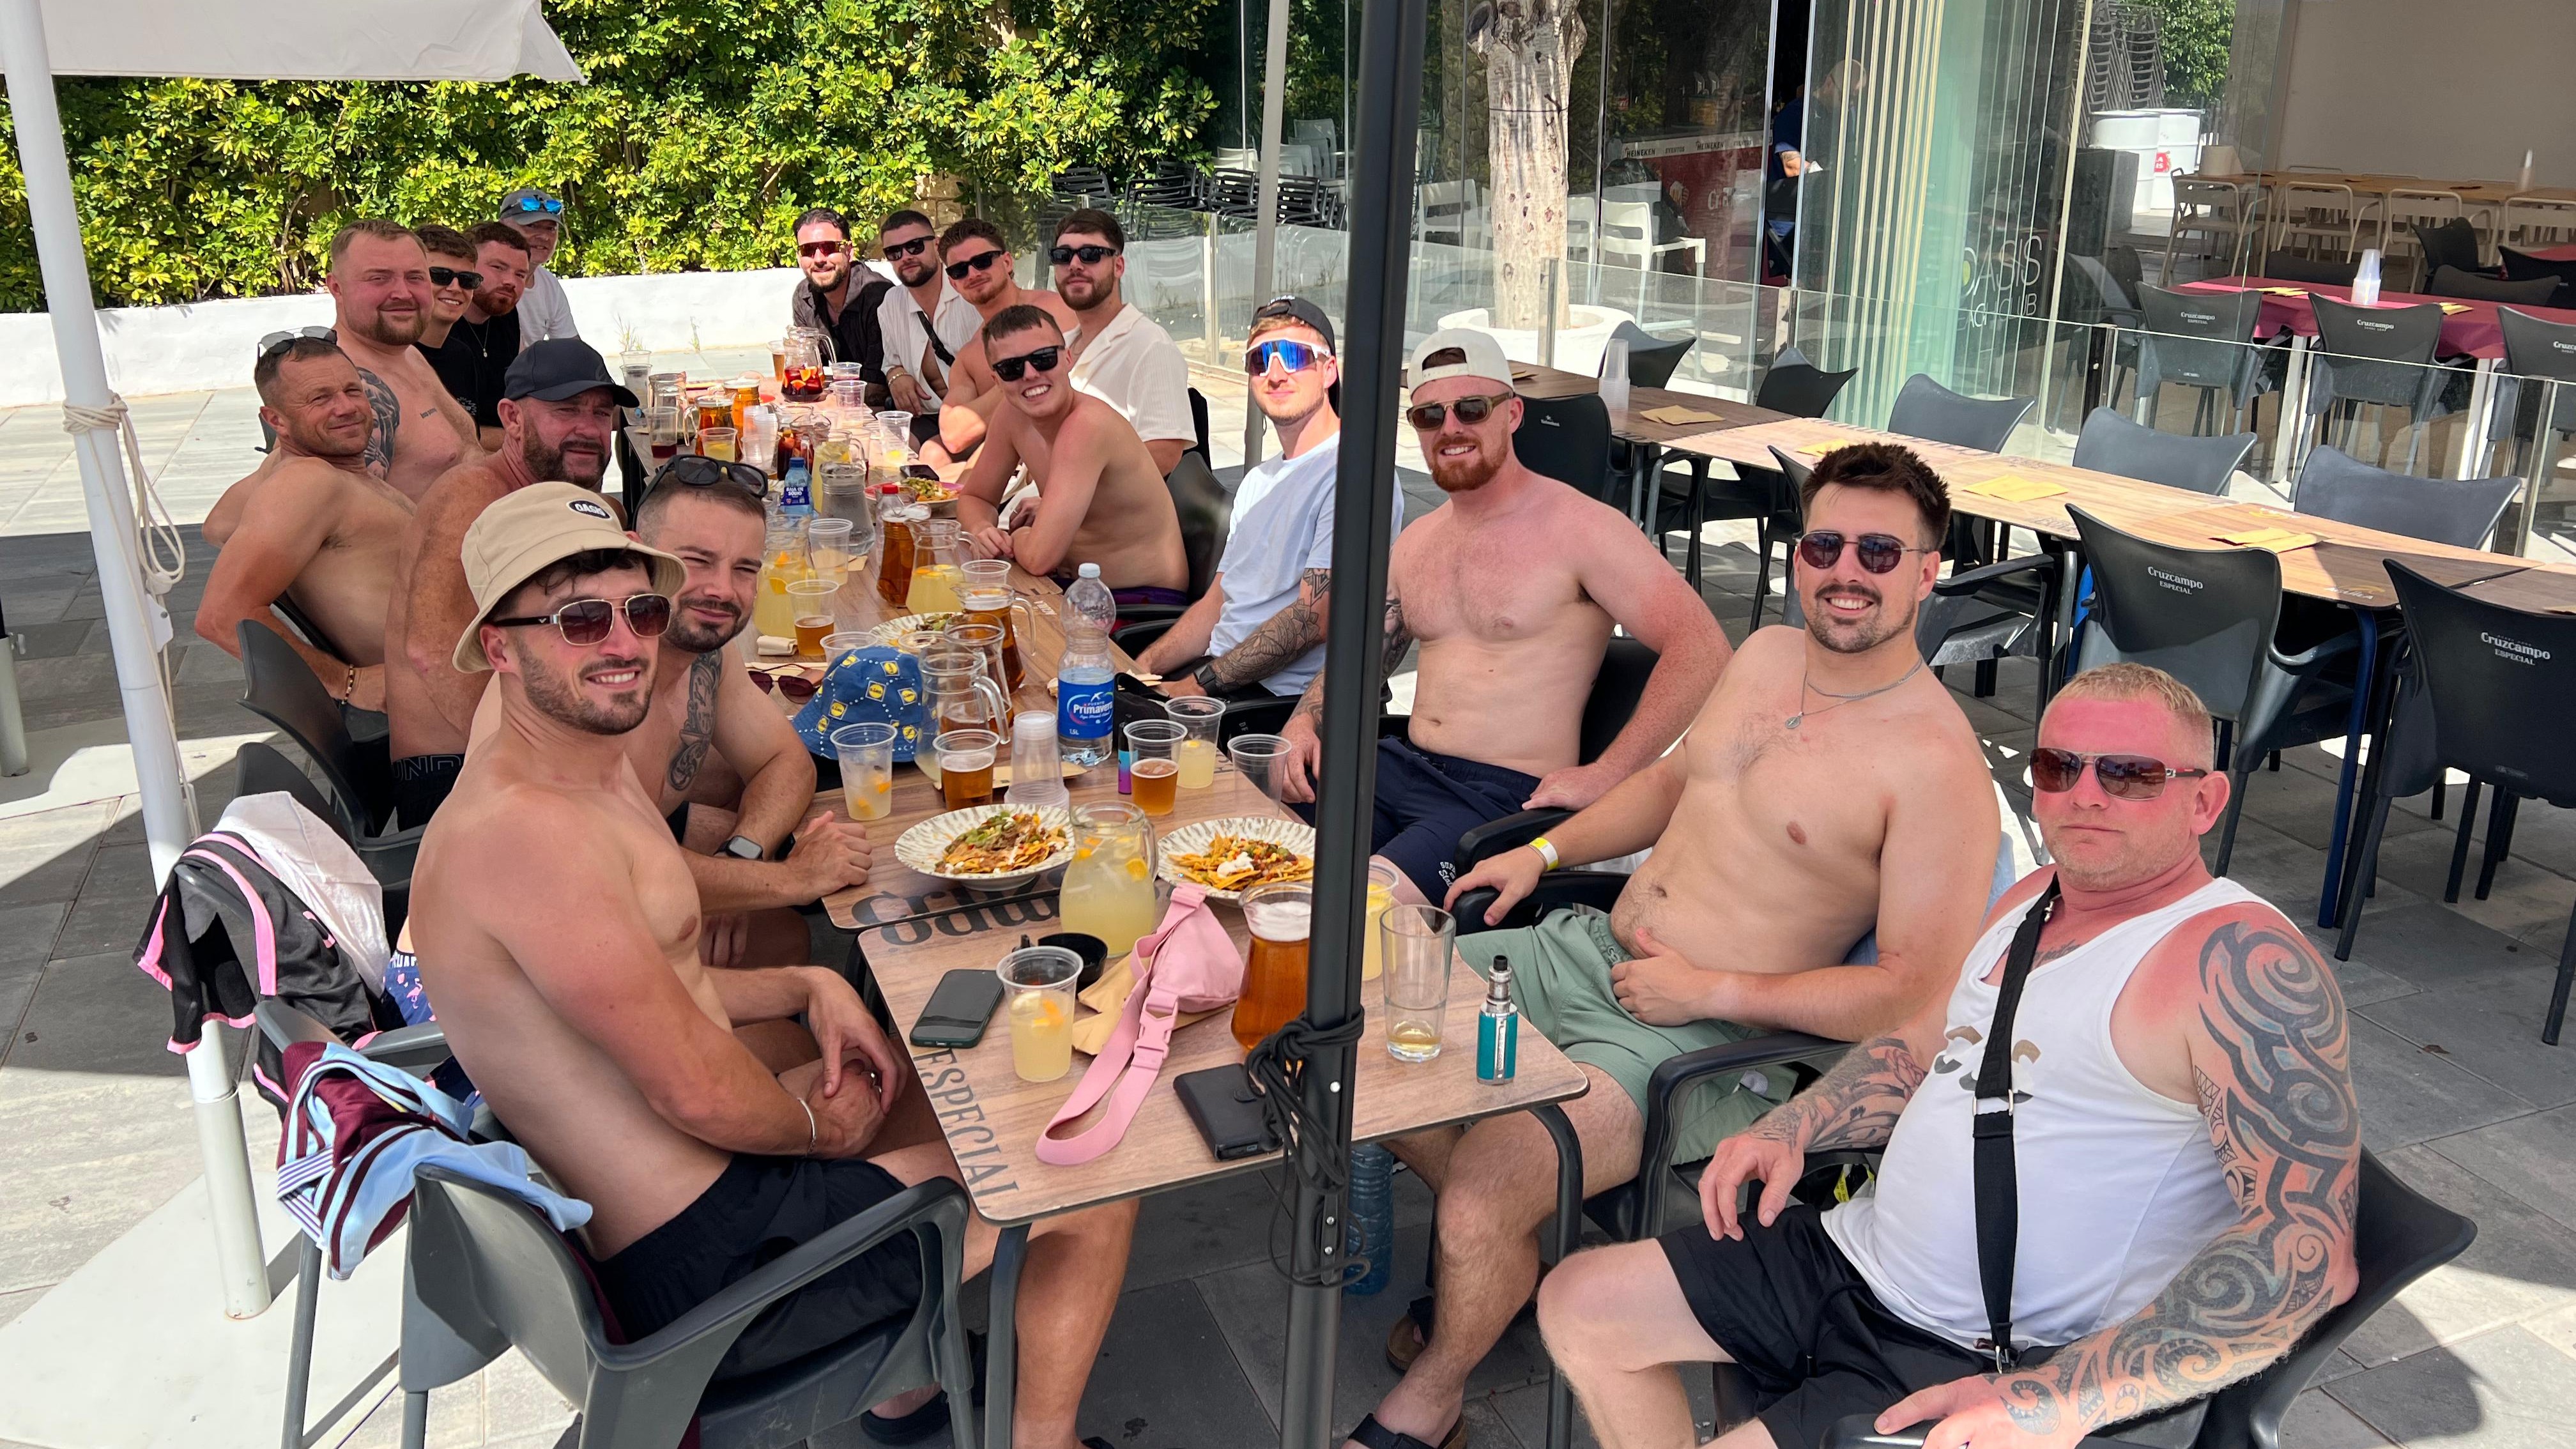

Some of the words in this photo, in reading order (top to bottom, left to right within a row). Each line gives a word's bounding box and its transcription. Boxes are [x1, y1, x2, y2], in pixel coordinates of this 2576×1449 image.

[1627, 148, 1656, 157] HEINEKEN
[1697, 141, 1724, 150] HEINEKEN
[2356, 319, 2395, 330] Cruzcampo
[574, 503, 606, 516] OASIS
[2147, 566, 2203, 589] Cruzcampo
[2159, 580, 2193, 595] ESPECIAL
[2481, 632, 2550, 659] Cruzcampo
[2495, 648, 2536, 666] ESPECIAL
